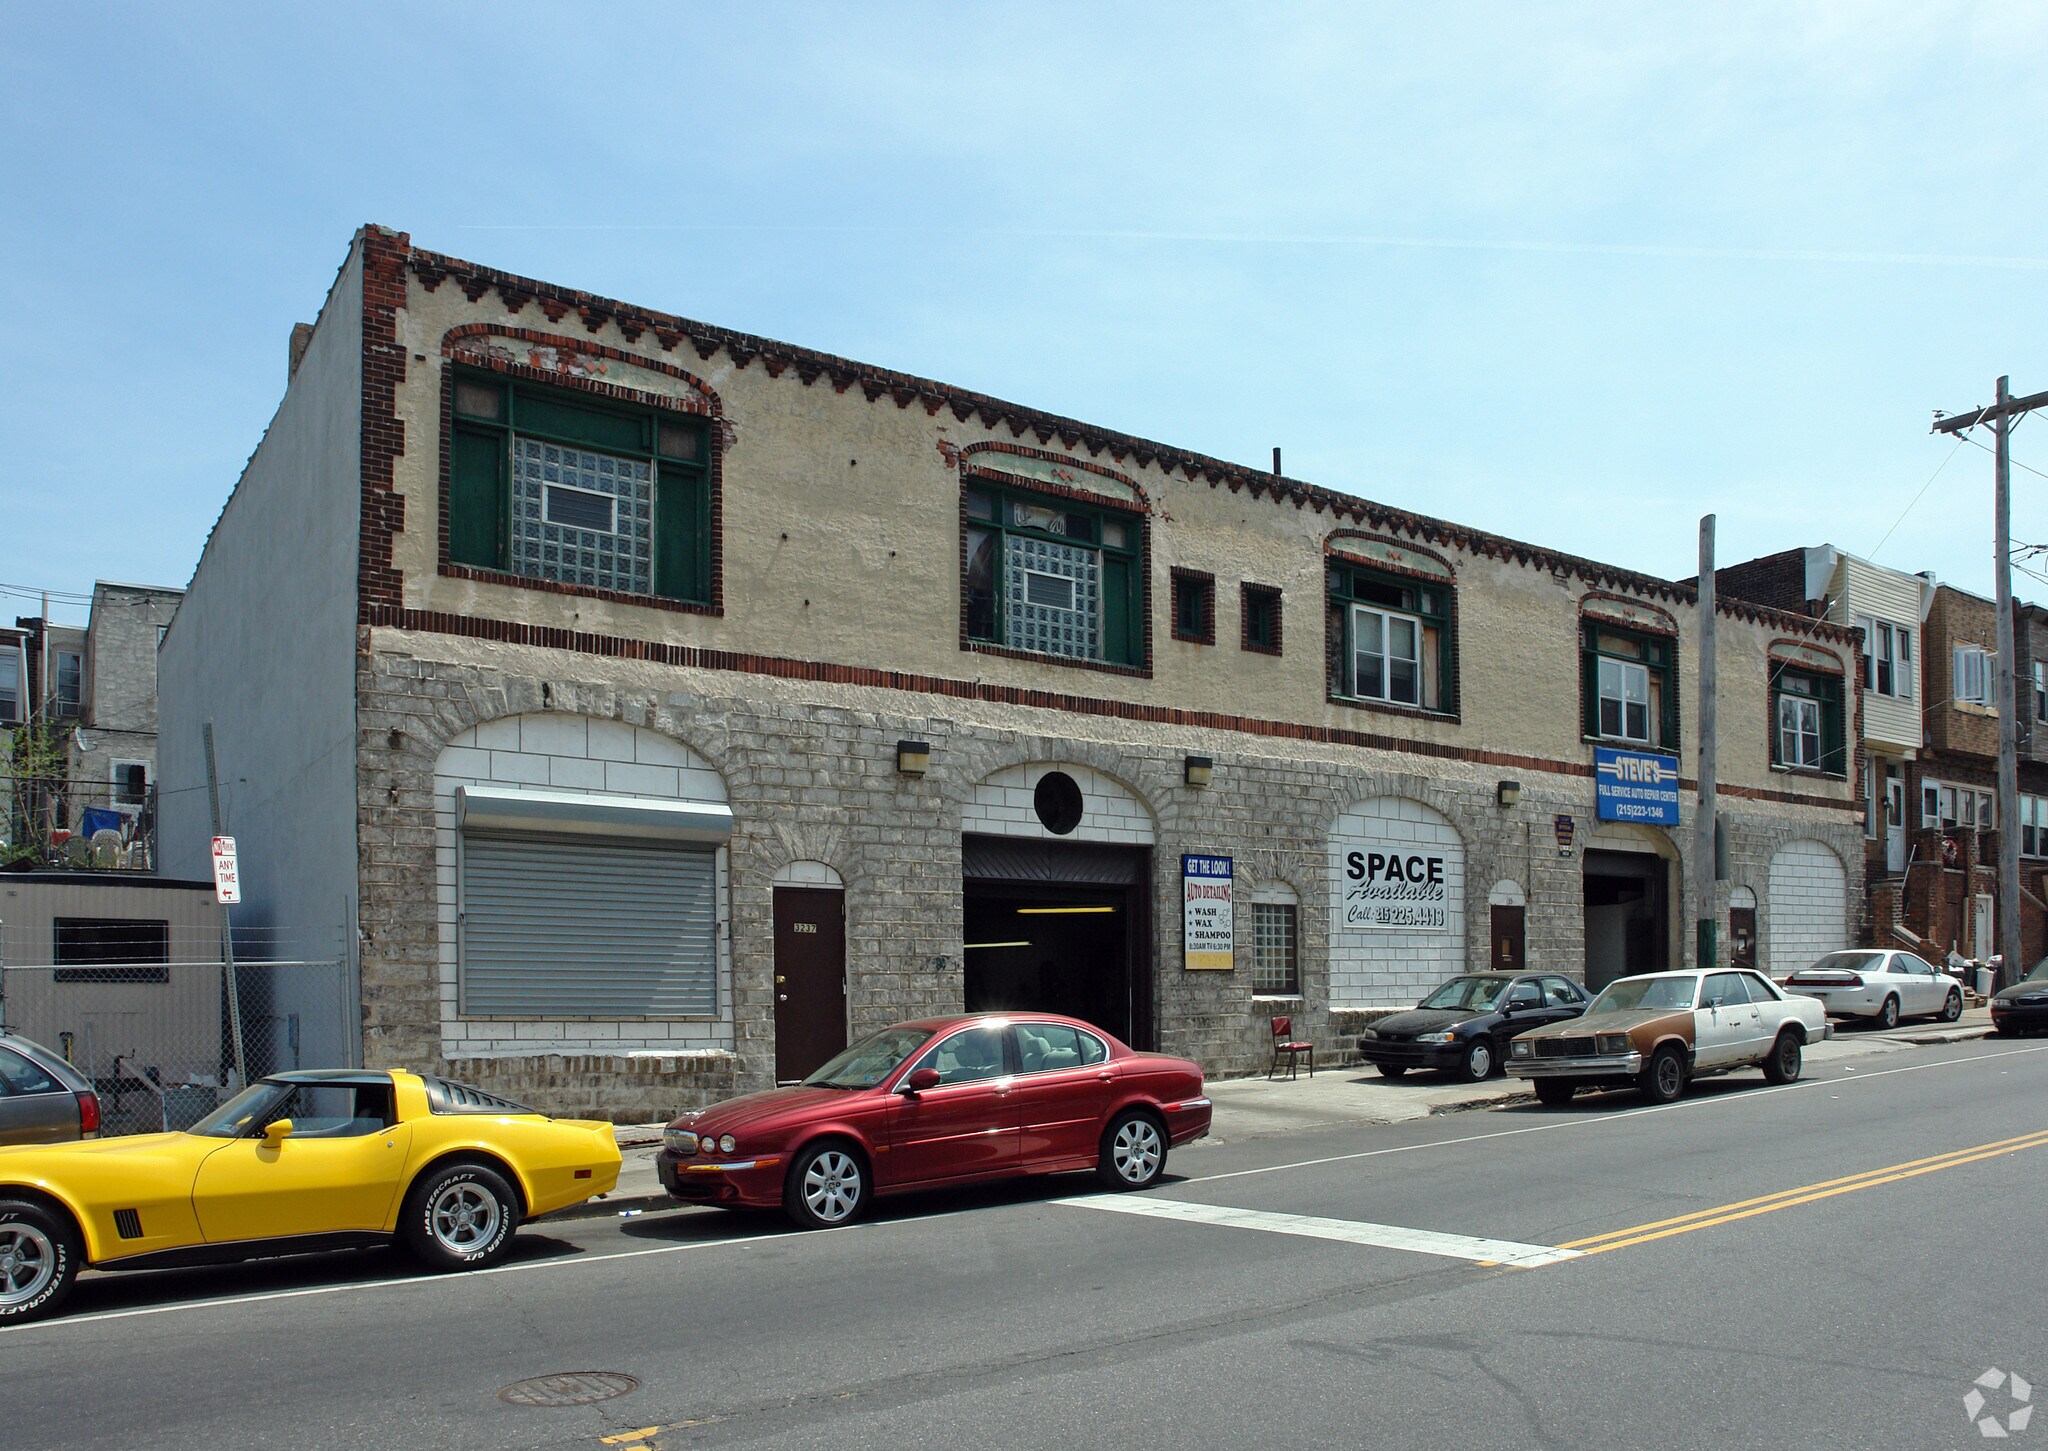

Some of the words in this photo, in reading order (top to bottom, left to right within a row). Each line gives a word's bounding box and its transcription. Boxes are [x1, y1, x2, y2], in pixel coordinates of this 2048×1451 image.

[1616, 756, 1661, 784] STEVE'S
[1598, 784, 1611, 796] FULL
[1611, 785, 1631, 798] SERVICE
[1631, 787, 1643, 800] AUTO
[1644, 788, 1660, 801] REPAIR
[1660, 790, 1678, 803] CENTER
[1616, 804, 1664, 818] (215)223-1346
[219, 860, 234, 870] ANY
[1187, 858, 1198, 873] GET
[1199, 859, 1210, 874] THE
[1211, 860, 1230, 875] LOOK!
[1346, 851, 1444, 884] SPACE
[219, 873, 236, 883] TIME
[1187, 881, 1202, 903] AUTO
[1203, 883, 1231, 904] DETAILING
[1345, 877, 1444, 901] Available
[1194, 907, 1217, 916] WASH
[1347, 904, 1375, 923] Call:
[795, 923, 816, 932] 3237
[1194, 919, 1213, 928] WAX
[1194, 930, 1231, 939] SHAMPOO
[424, 1173, 475, 1236] MASTERCRAFT
[487, 1204, 510, 1253] AVENGER
[463, 1252, 485, 1262] G/T
[0, 1243, 66, 1316] MASTERCRAFT
